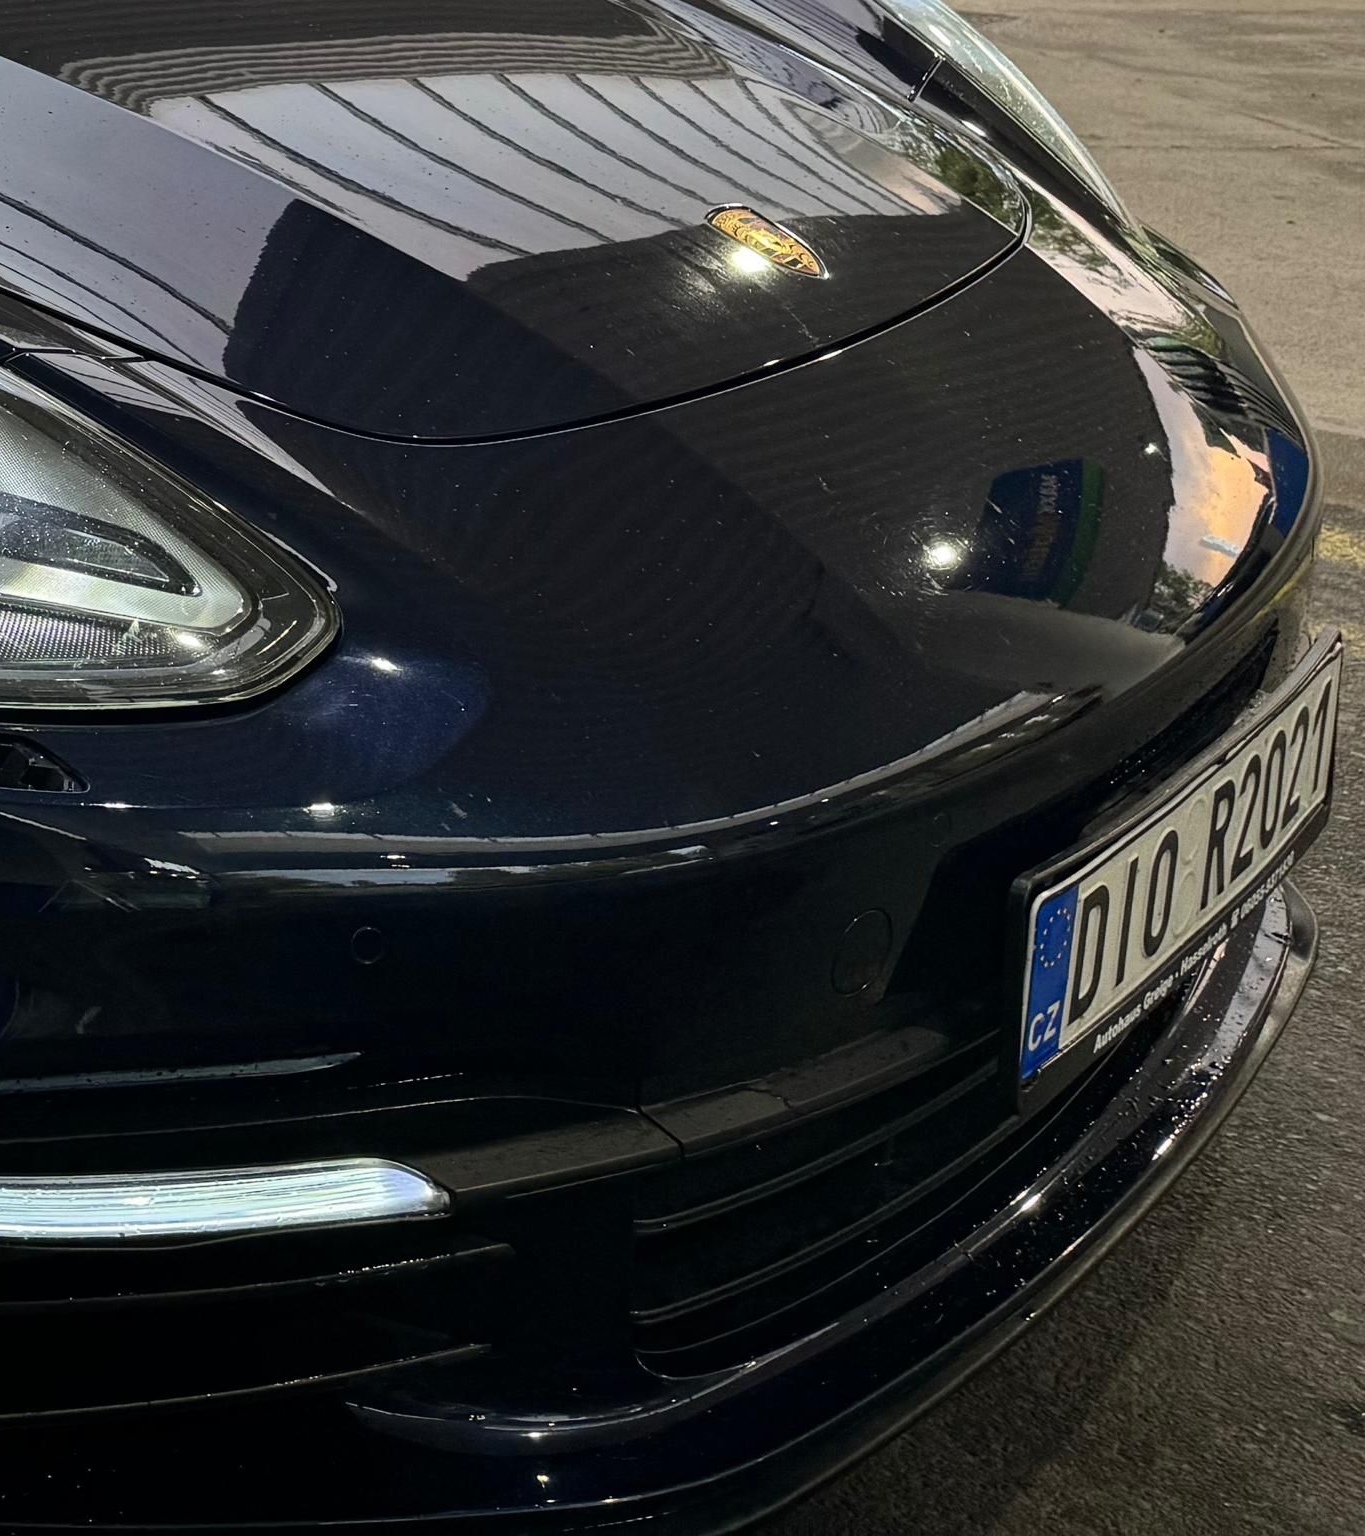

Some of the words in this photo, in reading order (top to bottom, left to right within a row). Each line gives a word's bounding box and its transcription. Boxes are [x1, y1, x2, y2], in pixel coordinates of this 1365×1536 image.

[1201, 676, 1333, 911] R2021
[1028, 999, 1061, 1052] CZ
[1093, 1002, 1142, 1053] Autohaus
